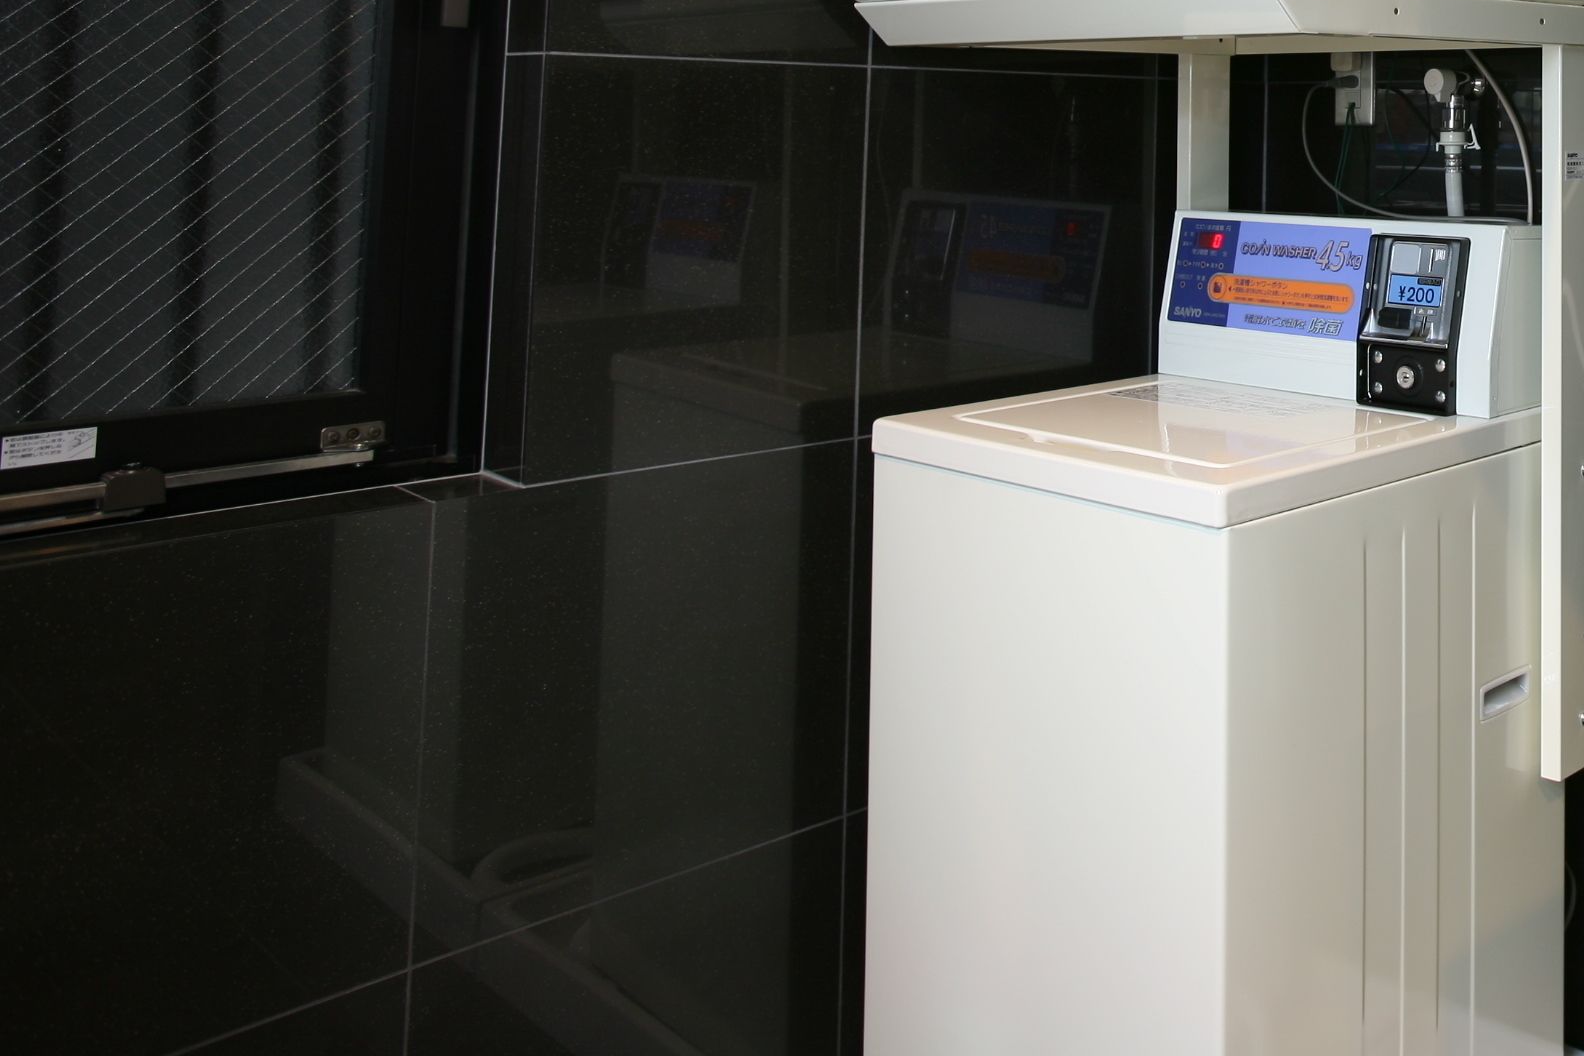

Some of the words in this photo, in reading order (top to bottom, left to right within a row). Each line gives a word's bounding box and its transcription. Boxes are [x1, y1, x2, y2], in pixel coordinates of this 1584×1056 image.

[1272, 244, 1317, 260] WASHER
[1397, 286, 1435, 304] ¥200
[1173, 305, 1202, 318] SANYO
[1307, 318, 1344, 336] 除菌
